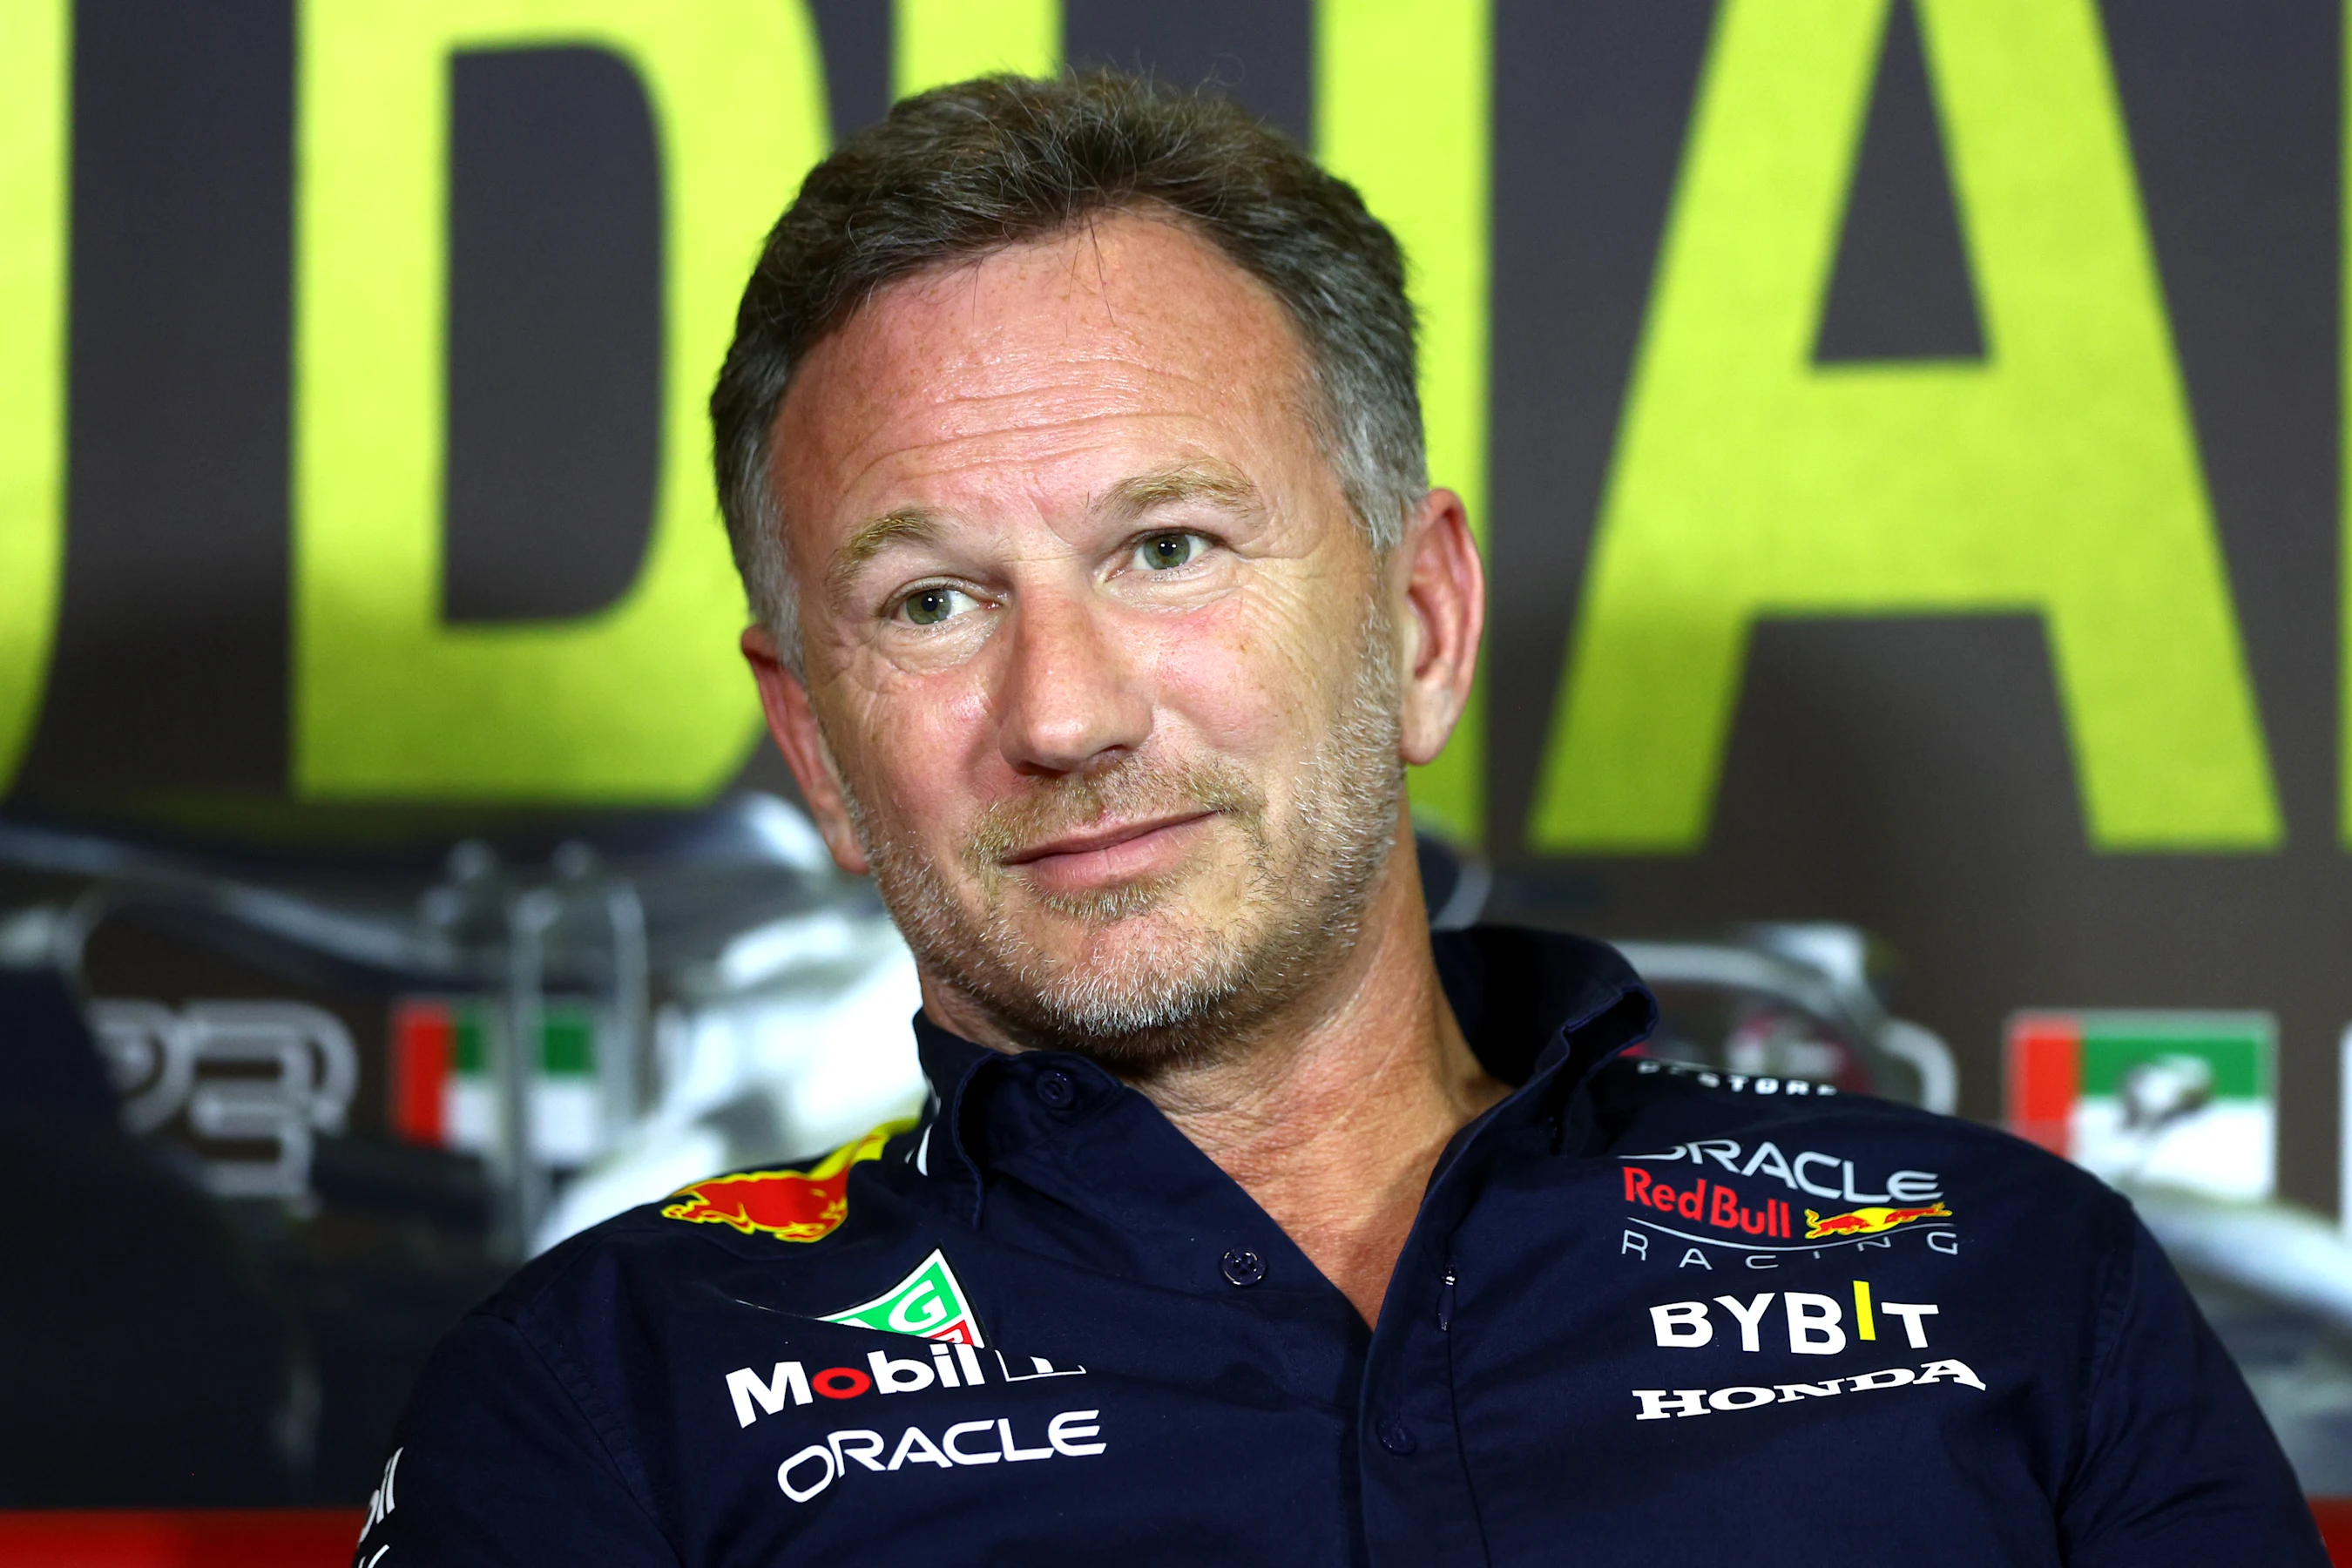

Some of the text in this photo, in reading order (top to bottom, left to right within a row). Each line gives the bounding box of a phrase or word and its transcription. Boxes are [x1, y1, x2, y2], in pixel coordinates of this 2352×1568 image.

[1637, 1060, 1838, 1097] CSTORE
[1621, 1229, 1958, 1271] RACING
[1649, 1281, 1940, 1355] BYBIT
[726, 1342, 986, 1429] Mobil
[1631, 1359, 1987, 1421] HONDA
[777, 1409, 1107, 1504] ORACLE
